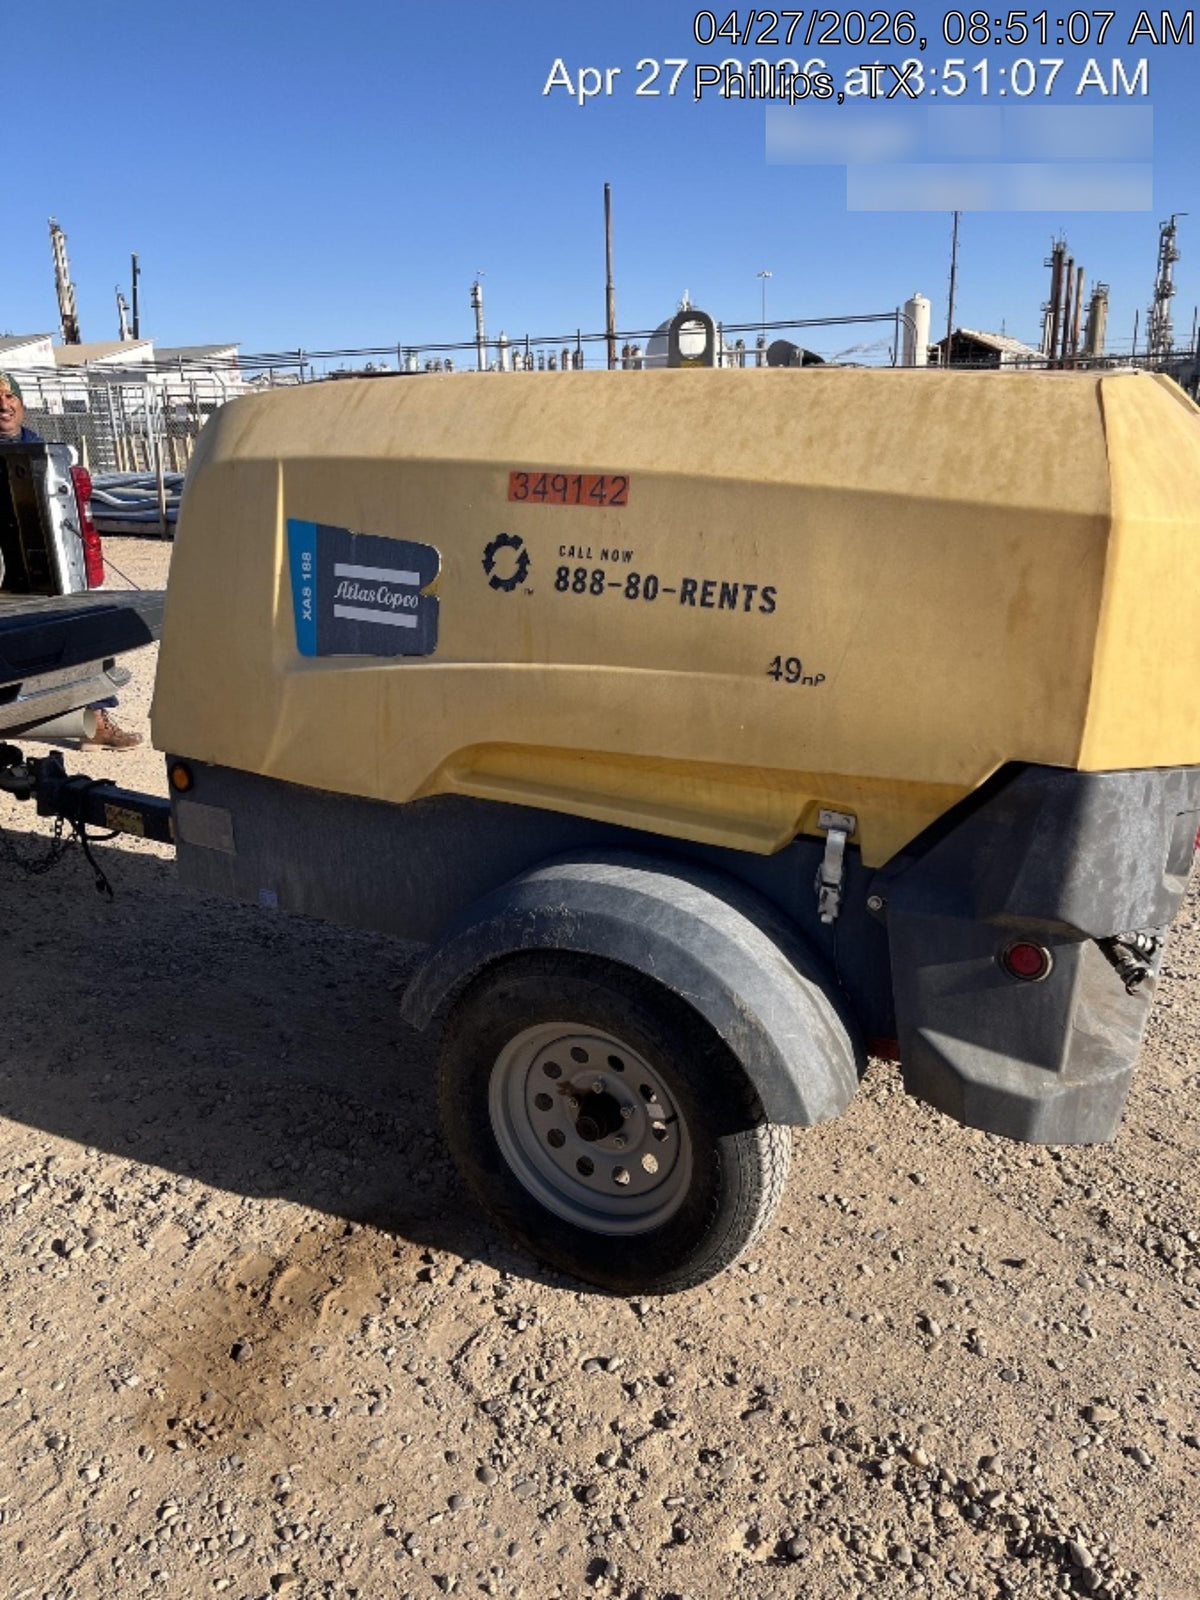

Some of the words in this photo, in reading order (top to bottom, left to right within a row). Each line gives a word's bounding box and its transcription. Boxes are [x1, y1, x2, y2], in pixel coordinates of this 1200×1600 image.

[513, 472, 628, 506] 349142
[302, 552, 312, 580] 188
[559, 545, 593, 559] CALL
[600, 547, 634, 563] NOW
[554, 566, 778, 614] 888-80-RENTS
